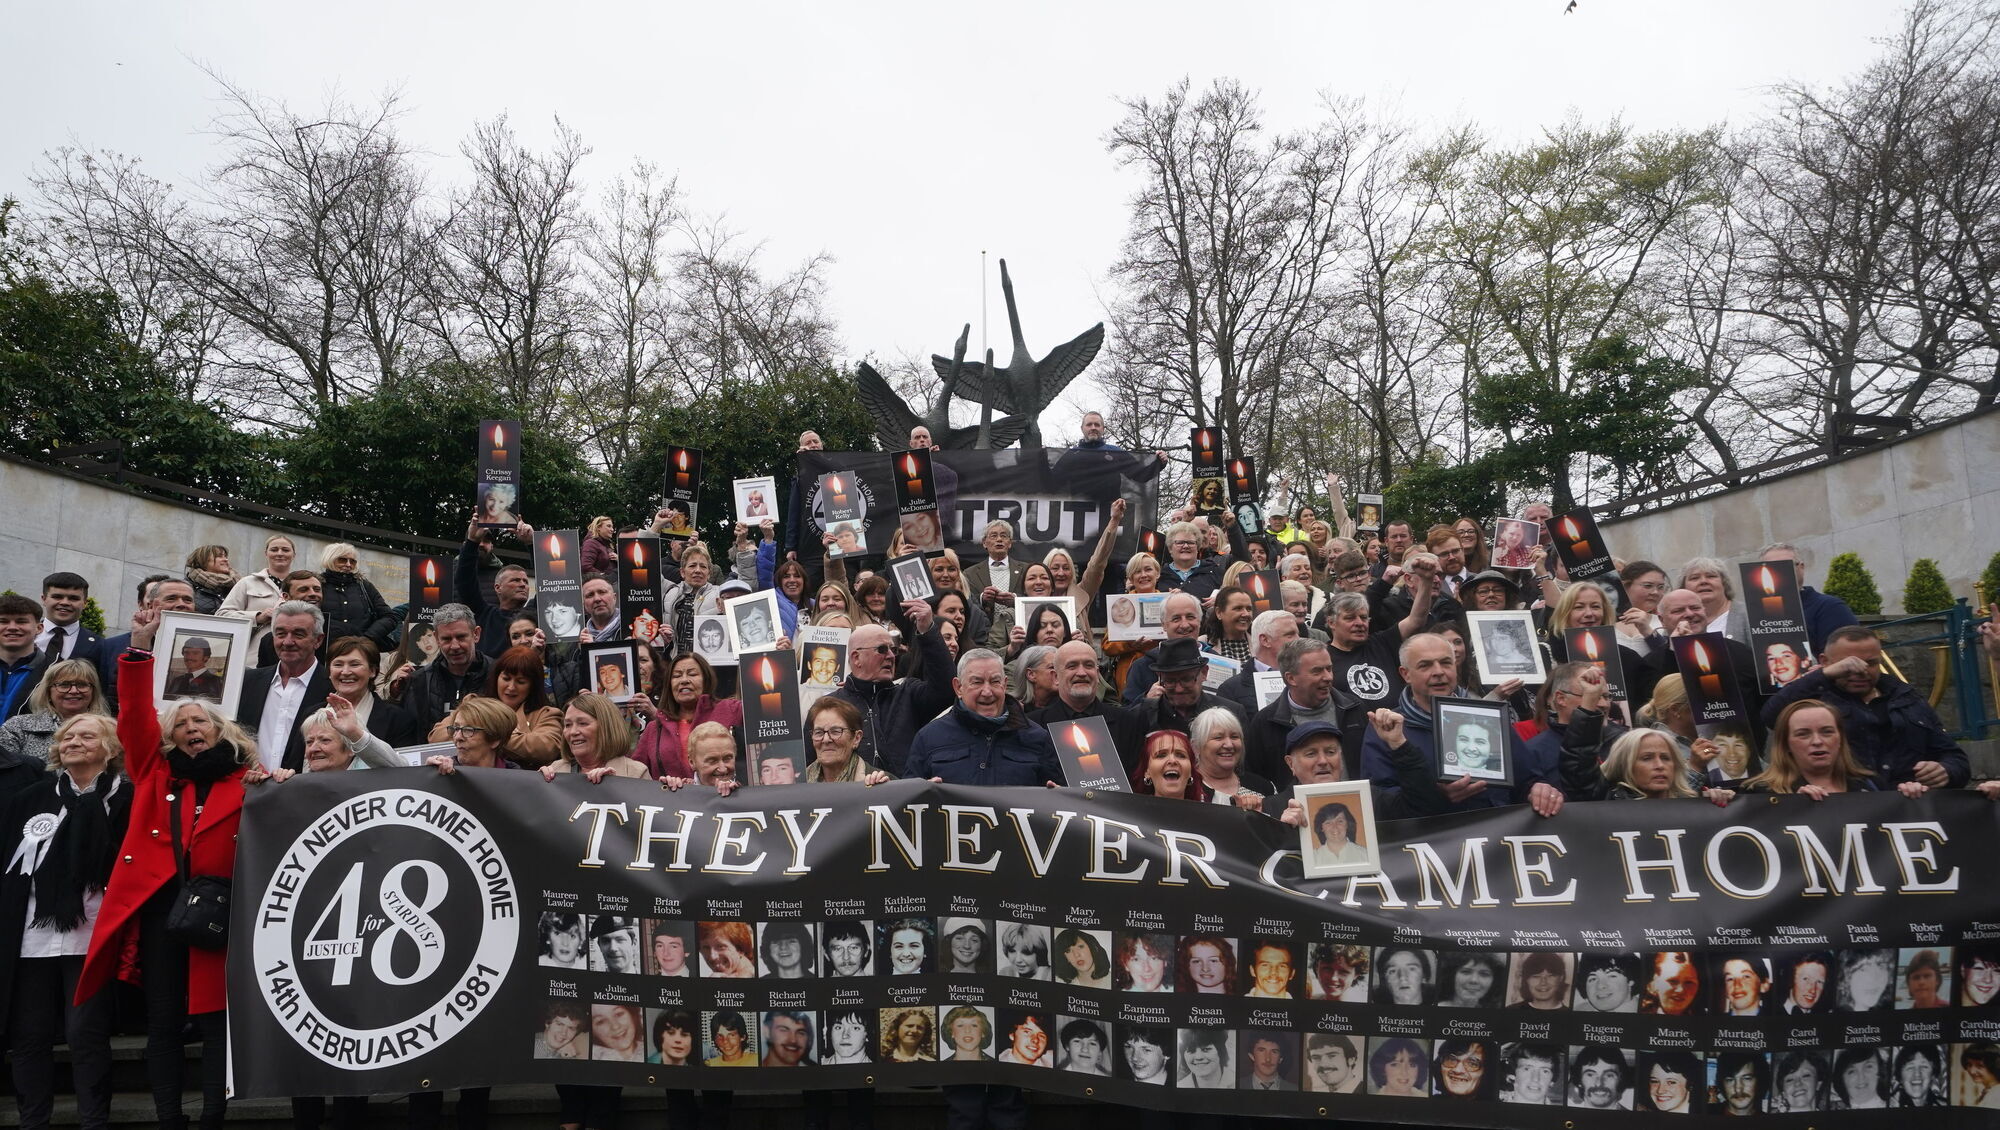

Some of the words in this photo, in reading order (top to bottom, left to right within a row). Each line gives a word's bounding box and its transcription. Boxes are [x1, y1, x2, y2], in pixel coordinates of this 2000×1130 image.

[485, 468, 513, 477] Chrissy
[485, 474, 512, 482] Keegan
[805, 487, 816, 508] THEY
[861, 483, 876, 508] HOME
[908, 498, 927, 506] Julie
[900, 502, 937, 514] McDonnell
[1568, 555, 1609, 575] Jacqueline
[1577, 564, 1605, 577] Croker
[539, 583, 580, 593] Loughman
[542, 578, 576, 587] Eamonn
[629, 589, 652, 597] David
[627, 595, 654, 603] Morton
[1760, 619, 1793, 627] George
[813, 629, 840, 637] Jimmy
[1751, 625, 1805, 635] McDermott
[811, 635, 841, 643] Buckley
[1356, 670, 1382, 691] 48
[1705, 701, 1729, 711] John
[1702, 709, 1736, 720] Keegan
[759, 719, 787, 729] Brian
[758, 727, 790, 738] Hobbs
[1079, 777, 1117, 788] Sandra
[569, 801, 829, 876] THEY
[863, 803, 1231, 890] NEVER
[1608, 821, 1962, 903] HOME
[262, 852, 308, 929] THEY
[301, 795, 387, 857] NEVER
[394, 794, 477, 844] CAME
[468, 837, 514, 921] HOME
[542, 889, 579, 901] Maureen
[597, 893, 629, 905] Francis
[884, 894, 927, 905] Kathleen
[546, 897, 575, 908] Lawlor
[655, 897, 680, 907] Brian
[707, 899, 743, 909] Michael
[765, 900, 803, 910] Michael
[824, 898, 866, 908] Brendan
[952, 895, 977, 907] Mary
[599, 902, 628, 913] Lawlor
[653, 905, 682, 916] Hobbs
[709, 907, 741, 917] Farrell
[825, 906, 865, 917] O'Meara
[884, 903, 927, 914] Muldoon
[950, 903, 980, 915] Kenny
[999, 900, 1047, 914] Josephine
[1070, 906, 1095, 918] Mary
[767, 908, 802, 918] Barrett
[1012, 909, 1034, 920] Glen
[1128, 910, 1163, 921] Helena
[302, 859, 449, 986] 48
[383, 890, 439, 950] STARDUST
[1065, 914, 1101, 926] Keegan
[1125, 918, 1166, 930] Mangan
[1194, 914, 1224, 924] Paula
[1255, 917, 1292, 930] Jimmy
[359, 914, 386, 936] for
[1193, 922, 1225, 933] Byrne
[1320, 921, 1361, 933] Thelma
[1393, 925, 1422, 936] John
[1776, 925, 1817, 935] William
[1846, 924, 1878, 934] Paula
[1909, 923, 1944, 933] Robert
[1253, 925, 1295, 938] Buckley
[1323, 929, 1358, 941] Frazer
[1444, 928, 1500, 940] Jacqueline
[1514, 929, 1559, 939] Marcella
[1580, 929, 1623, 939] Michael
[1644, 928, 1694, 939] Margaret
[1716, 926, 1752, 937] George
[1393, 934, 1422, 945] Stout
[1457, 936, 1492, 947] Croker
[1511, 937, 1570, 947] McDermott
[1584, 938, 1626, 948] Ffrench
[1645, 936, 1697, 946] Thornton
[1708, 936, 1762, 945] McDermott
[1769, 934, 1829, 945] McDermott
[1850, 933, 1880, 943] Lewis
[1915, 931, 1940, 944] Kelly
[306, 942, 360, 957] JUSTICE
[549, 979, 577, 990] Robert
[605, 984, 627, 995] Julie
[947, 984, 985, 994] Martina
[548, 987, 578, 999] Hillock
[660, 988, 681, 997] Paul
[714, 990, 745, 1000] James
[768, 990, 806, 1000] Richard
[835, 988, 860, 997] Liam
[887, 985, 927, 996] Caroline
[1011, 988, 1038, 1000] David
[593, 991, 640, 1003] McDonnell
[658, 996, 684, 1006] Wade
[716, 997, 744, 1007] Millar
[768, 997, 807, 1008] Bennett
[831, 995, 864, 1006] Dunne
[893, 994, 922, 1005] Carey
[949, 992, 984, 1003] Keegan
[1008, 996, 1042, 1008] Morton
[1067, 996, 1100, 1008] Donna
[264, 959, 301, 1021] 14th
[295, 1014, 440, 1065] FEBRUARY
[444, 963, 500, 1022] 1981
[1067, 1004, 1100, 1016] Mahon
[1123, 1003, 1166, 1015] Eamonn
[1191, 1006, 1223, 1017] Susan
[1253, 1009, 1289, 1020] Gerard
[1118, 1012, 1170, 1024] Loughman
[1188, 1014, 1225, 1026] Morgan
[1248, 1017, 1293, 1028] McGrath
[1321, 1013, 1349, 1024] John
[1377, 1015, 1425, 1028] Margaret
[1317, 1020, 1353, 1033] Colgan
[1380, 1023, 1421, 1035] Kiernan
[1449, 1019, 1486, 1031] George
[1519, 1022, 1550, 1032] David
[1583, 1023, 1624, 1035] Eugene
[1846, 1024, 1880, 1034] Sandra
[1903, 1021, 1940, 1032] Michael
[1441, 1026, 1493, 1038] O'Connor
[1519, 1030, 1549, 1039] Flood
[1585, 1032, 1620, 1043] Hogan
[1658, 1027, 1690, 1038] Marie
[1718, 1029, 1765, 1041] Murtagh
[1790, 1027, 1817, 1038] Carol
[1902, 1031, 1941, 1041] Griffiths
[1649, 1036, 1696, 1049] Kennedy
[1713, 1038, 1767, 1050] Kavanagh
[1787, 1036, 1820, 1047] Bissett
[1844, 1033, 1881, 1044] Lawless
